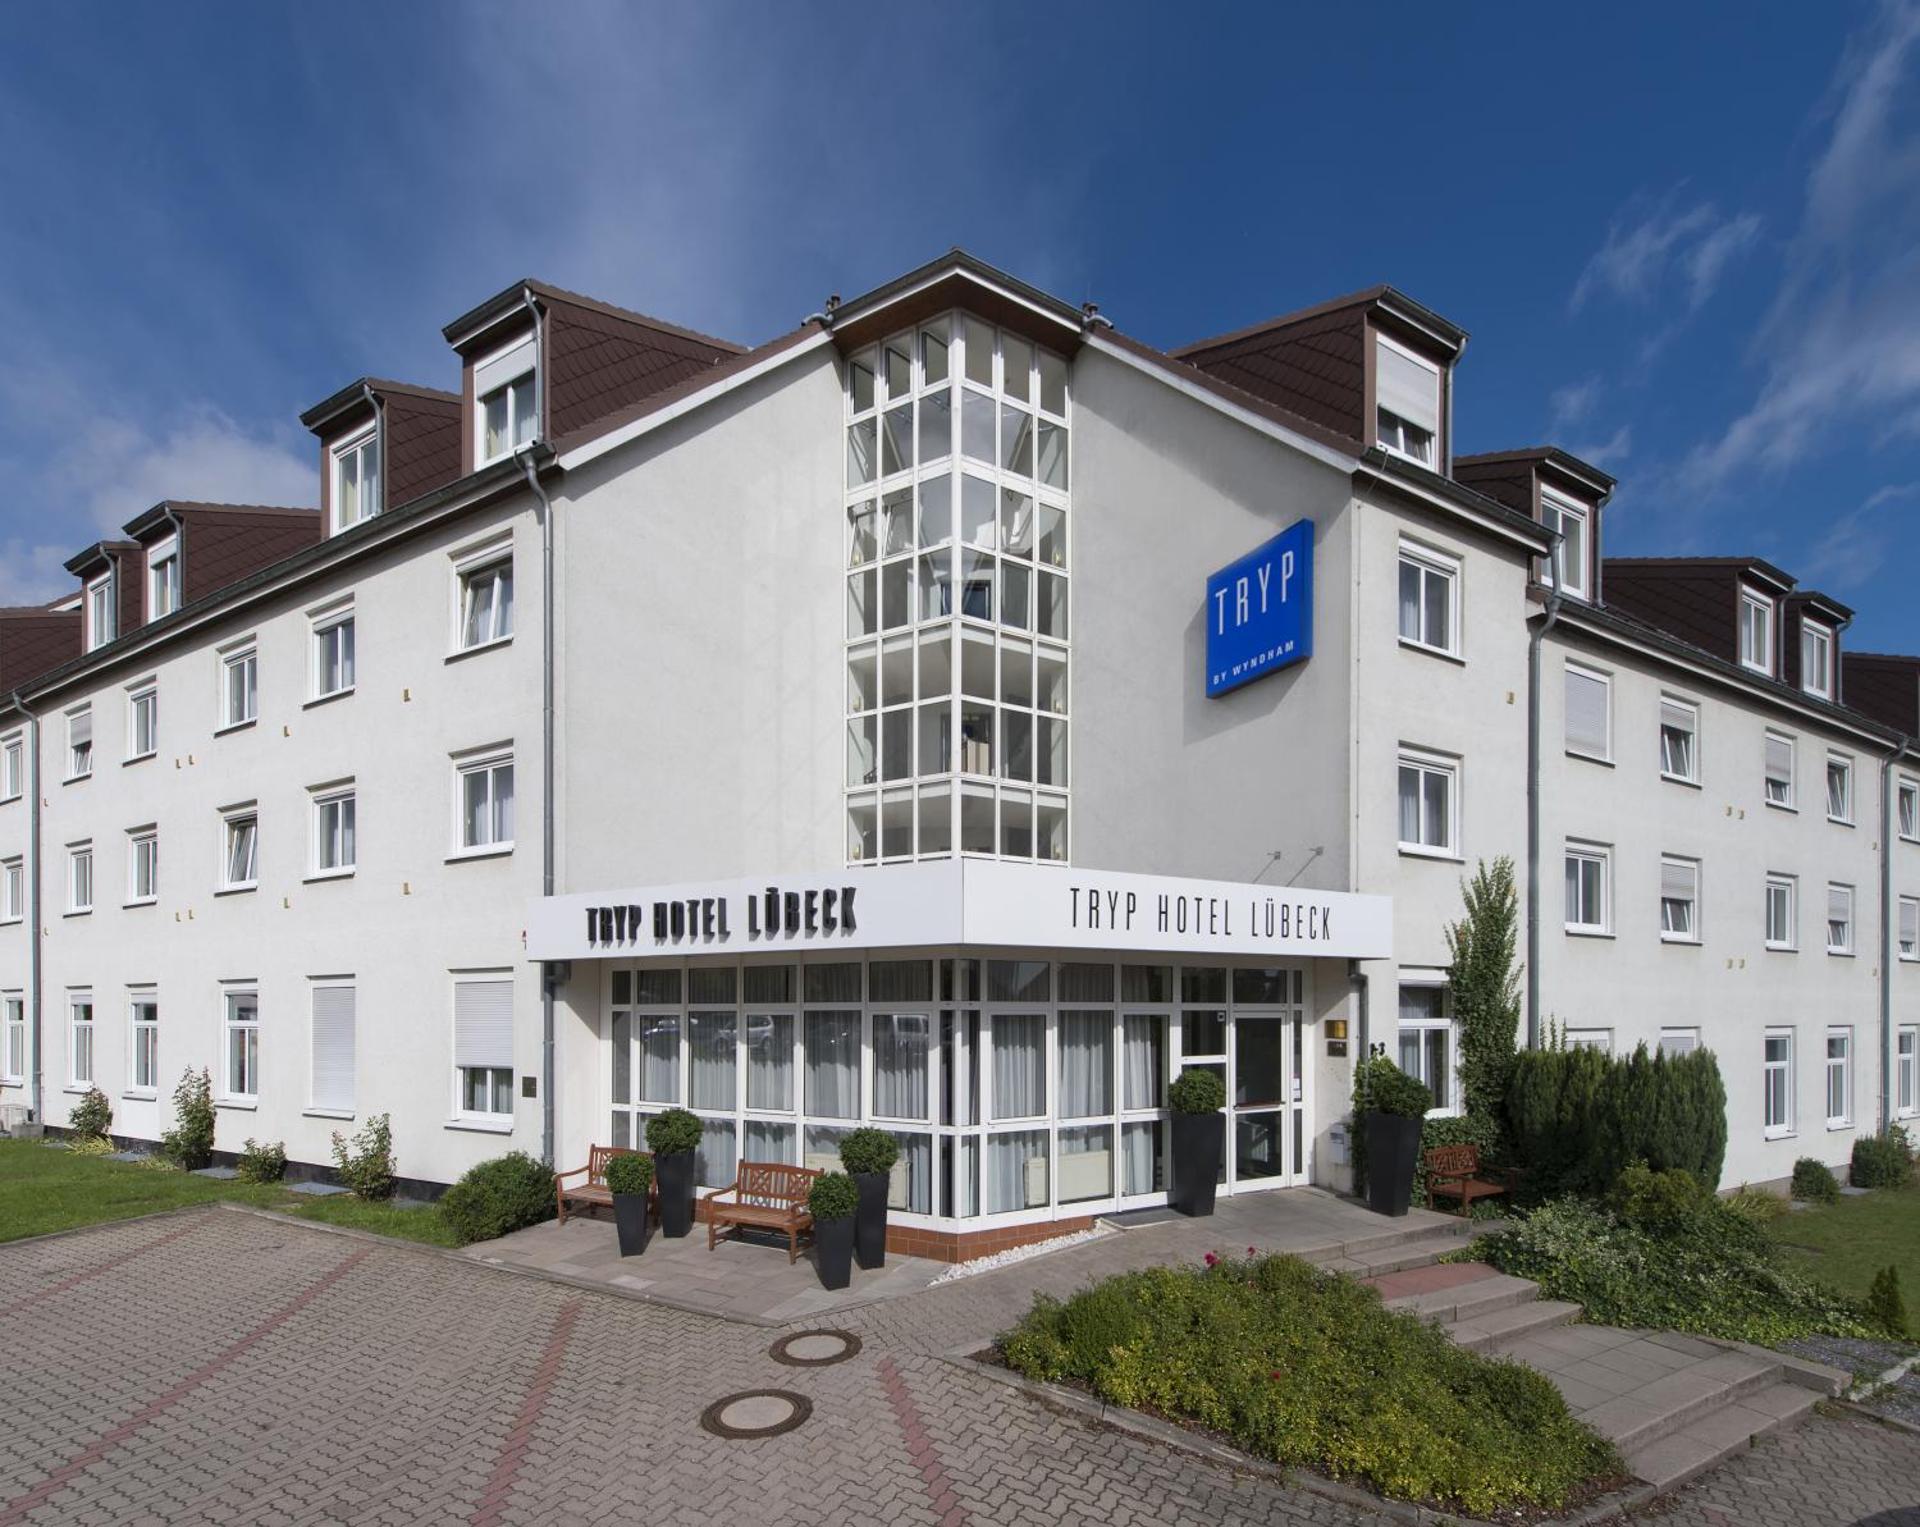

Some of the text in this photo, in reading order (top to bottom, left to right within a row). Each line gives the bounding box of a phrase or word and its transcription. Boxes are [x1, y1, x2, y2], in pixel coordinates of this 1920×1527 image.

[1215, 550, 1294, 635] TRYP
[1213, 640, 1294, 685] BY WYNDHAM
[585, 886, 857, 943] TRYP HOTEL LÜBECK
[1070, 887, 1330, 941] TRYP HOTEL LÜBECK
